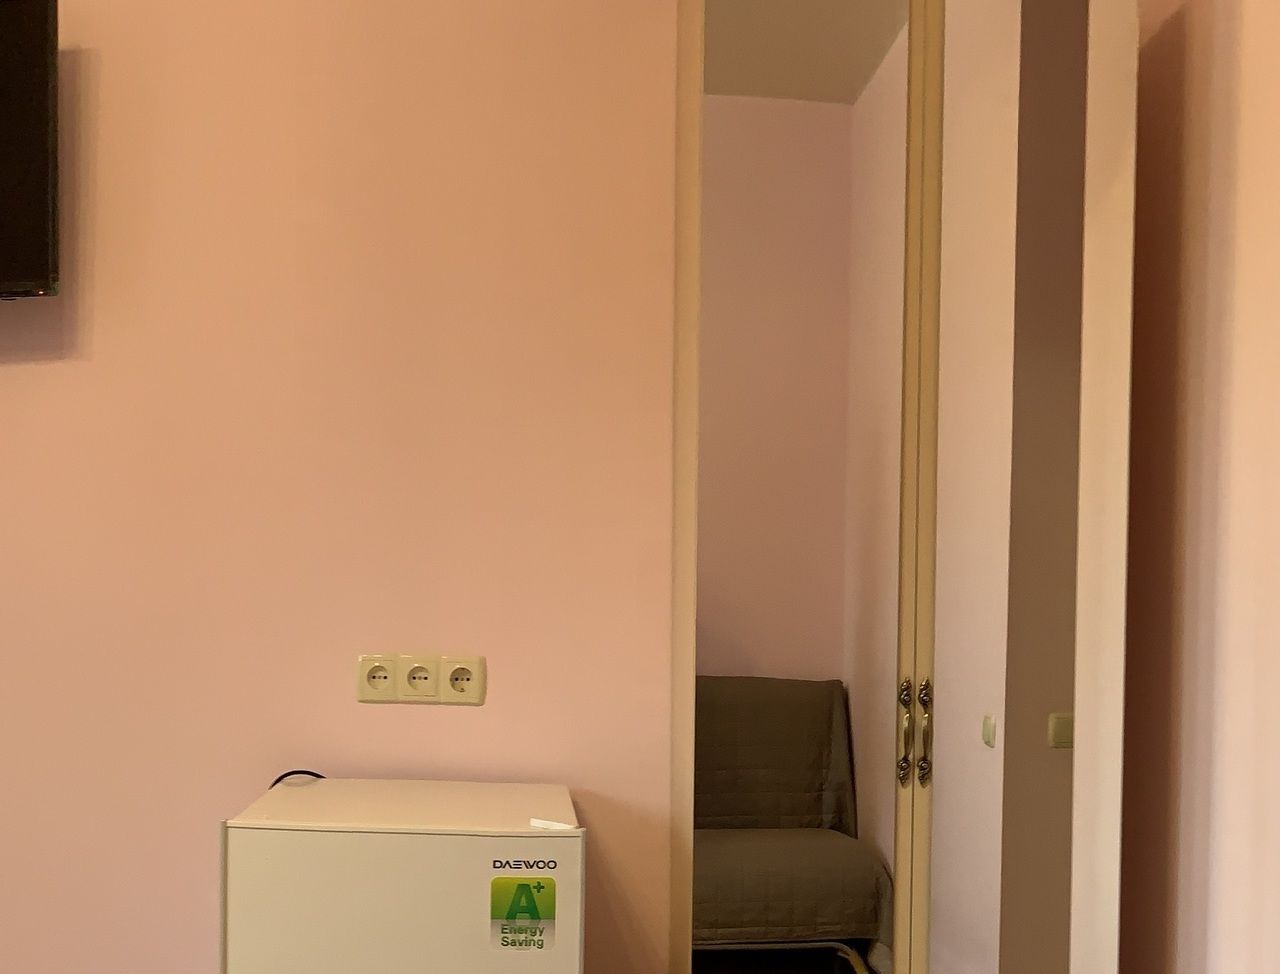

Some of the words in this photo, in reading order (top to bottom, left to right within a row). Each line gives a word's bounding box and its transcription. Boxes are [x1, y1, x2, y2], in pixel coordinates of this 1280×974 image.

[492, 860, 557, 869] DAEWOO
[500, 924, 545, 937] Energy
[500, 936, 545, 949] Saving
